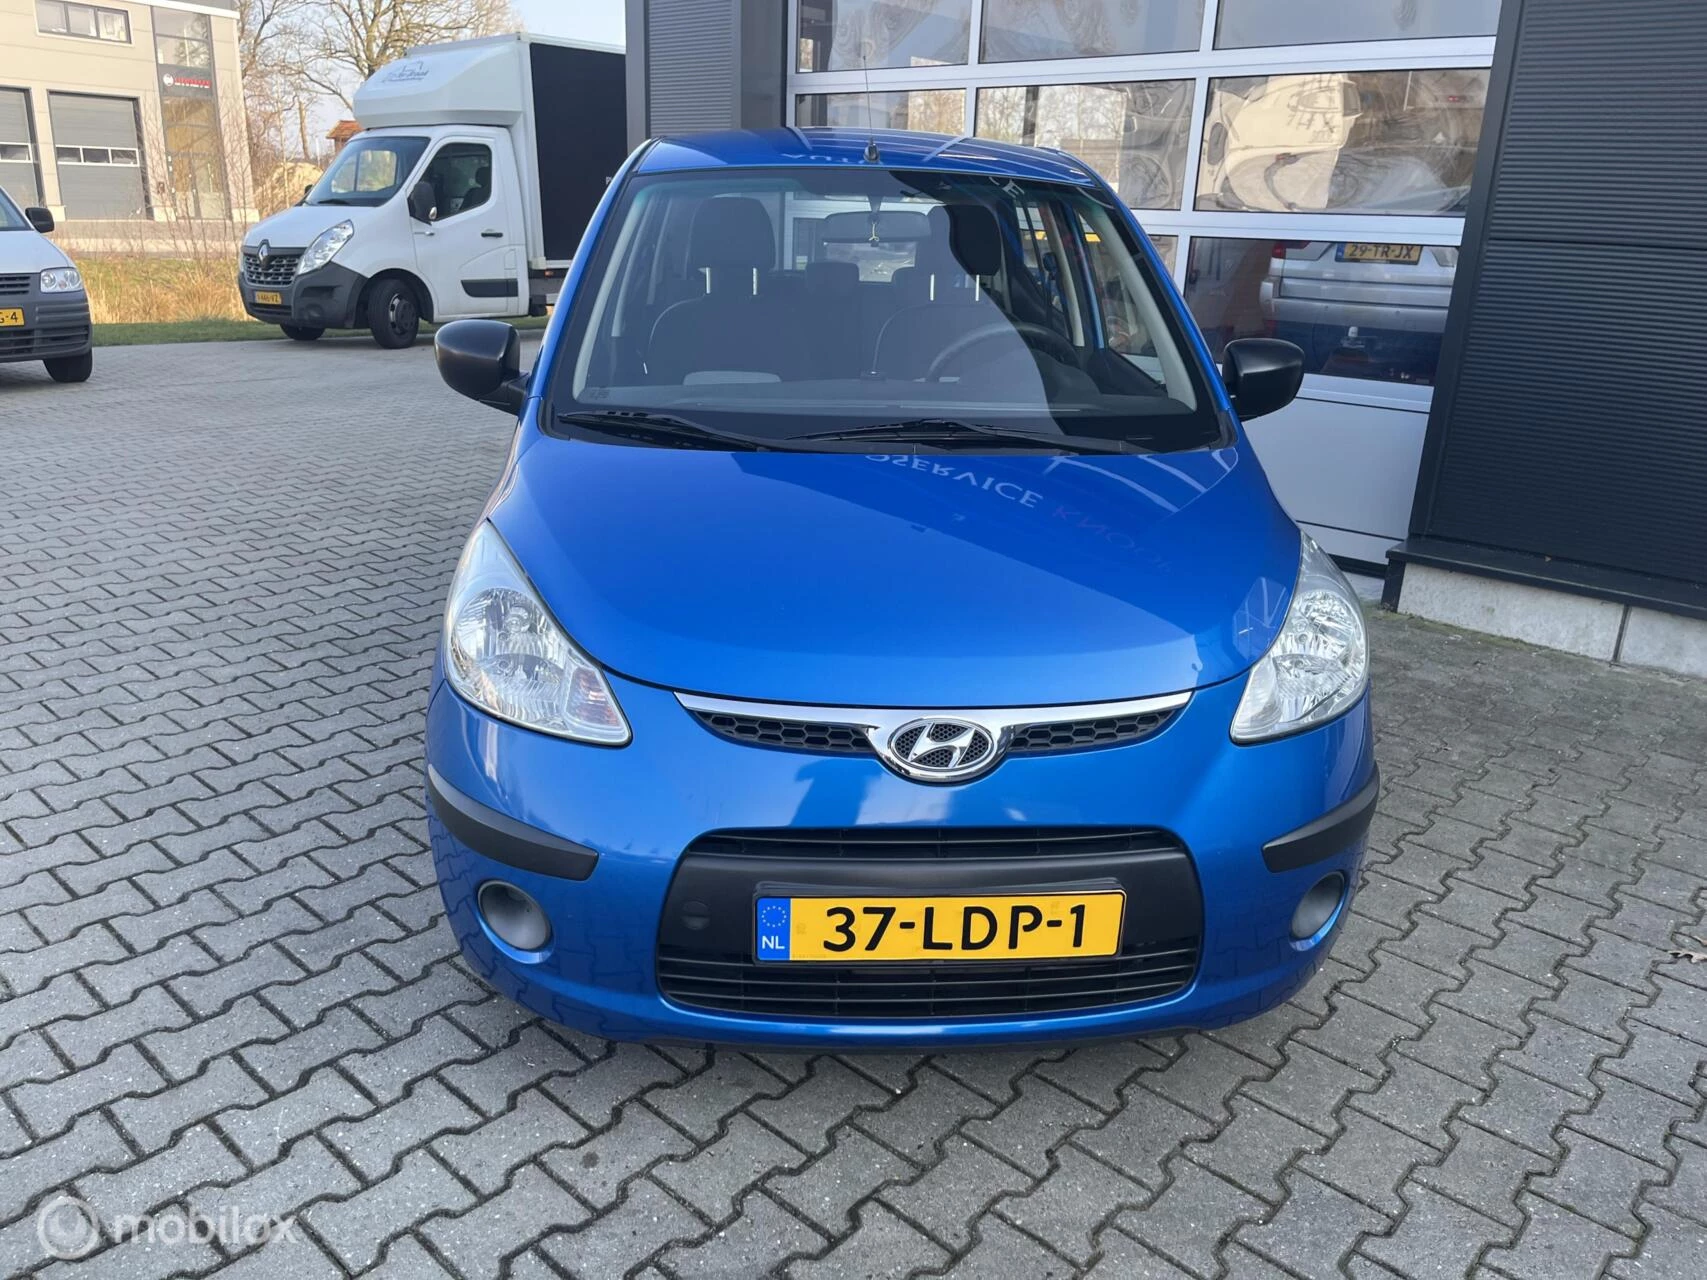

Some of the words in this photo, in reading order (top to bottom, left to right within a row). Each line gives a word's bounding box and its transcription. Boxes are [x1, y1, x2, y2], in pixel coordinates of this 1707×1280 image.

[1349, 244, 1415, 259] 29-TR-JX
[823, 904, 1086, 952] 37-LDP-1
[761, 935, 785, 950] NL
